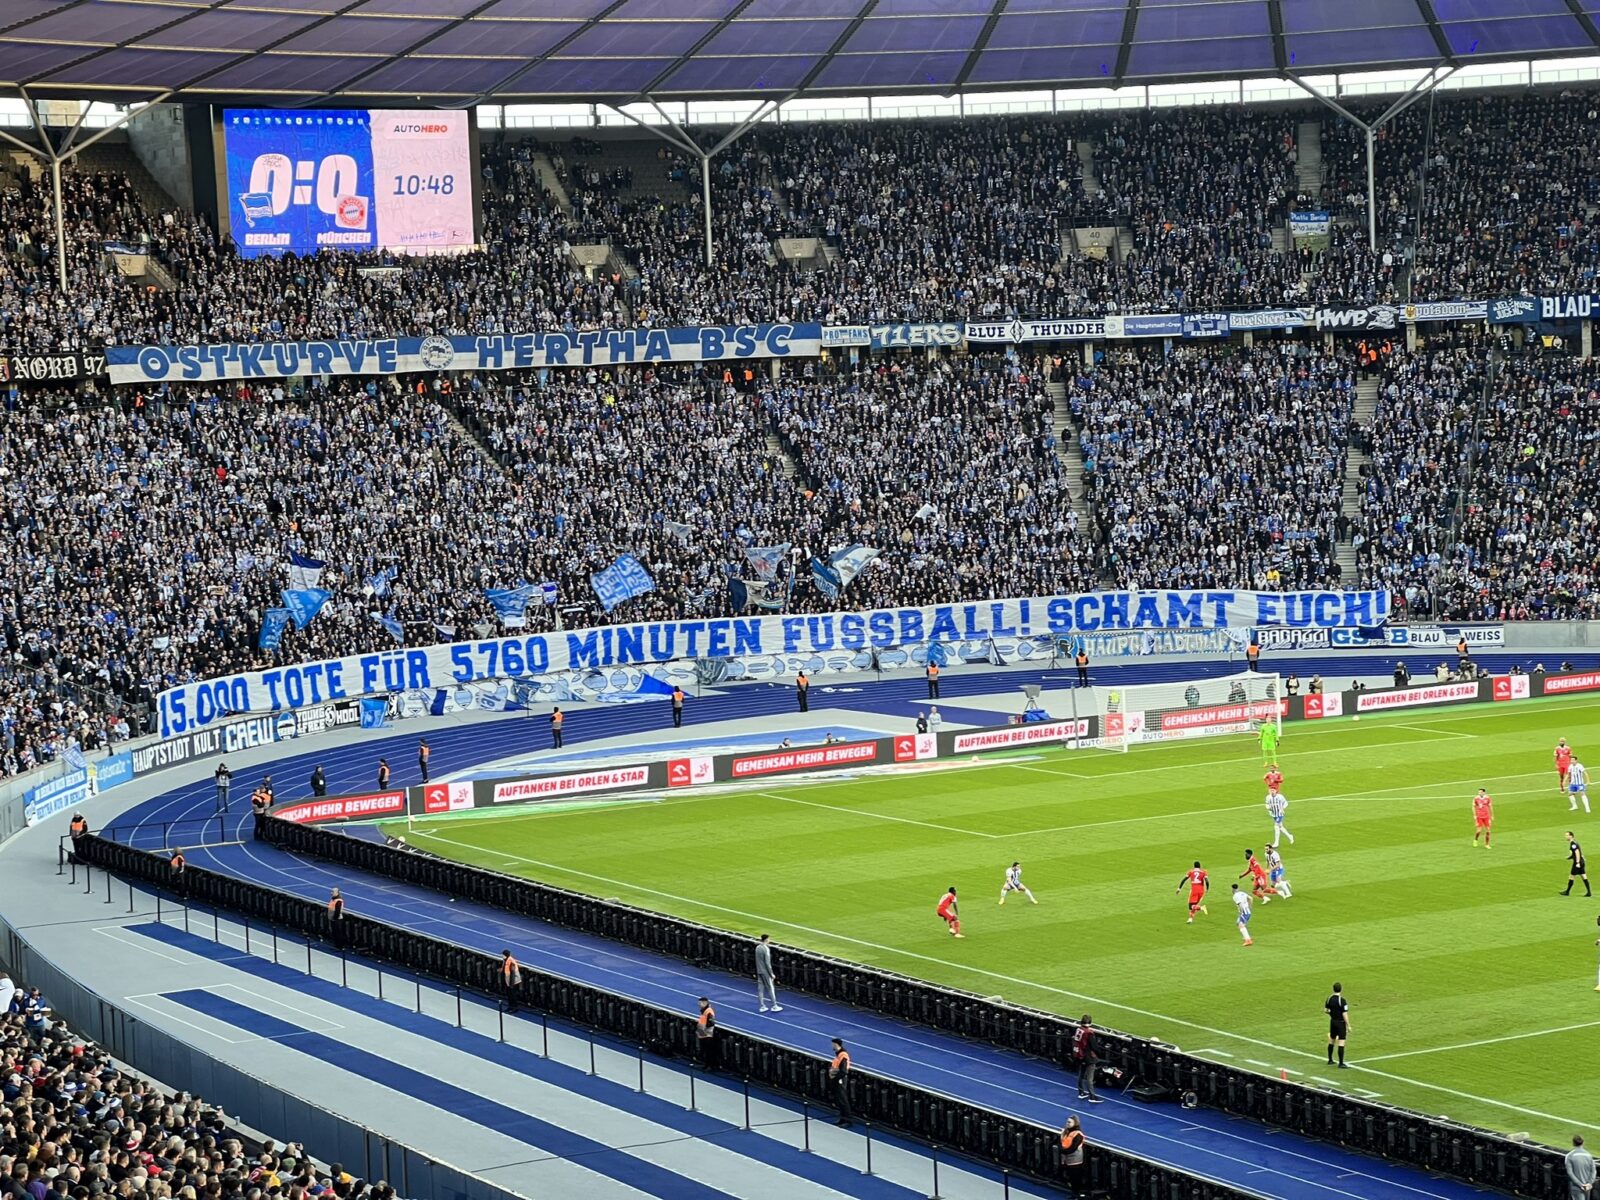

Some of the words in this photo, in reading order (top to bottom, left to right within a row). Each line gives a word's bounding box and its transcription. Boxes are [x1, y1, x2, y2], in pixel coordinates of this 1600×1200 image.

[393, 124, 448, 133] AUTOHERO
[249, 153, 358, 216] 0:0
[392, 174, 455, 195] 10:48
[245, 232, 290, 246] BERLIN
[316, 231, 371, 244] MÜNCHEN
[1230, 311, 1285, 327] Babelsberg
[871, 323, 963, 347] 71ERS
[967, 324, 1006, 339] BLUE
[1030, 322, 1105, 337] THUNDER
[137, 338, 398, 380] OSTKURVE
[474, 329, 673, 369] HERTHA
[699, 324, 795, 360] BSC
[12, 356, 78, 380] NORD
[1411, 632, 1440, 642] BLAU
[1464, 630, 1501, 641] WEISS
[158, 676, 250, 740] 15.000
[262, 661, 347, 711] TOTE
[360, 650, 431, 693] FÜR
[450, 636, 549, 683] 5.760
[566, 618, 763, 670] MINUTEN
[782, 598, 1030, 654] FUSSBALL!
[1047, 592, 1236, 634] SCHÄMT
[1255, 590, 1387, 627] EUCH!
[1546, 675, 1594, 690] GEMEINSAM
[1361, 694, 1406, 707] AUFTANKEN
[1408, 692, 1421, 702] BEI
[1423, 689, 1448, 700] ORLEN
[1449, 688, 1455, 696] &
[1456, 686, 1475, 696] STAR
[296, 707, 325, 722] YOUNG
[336, 707, 360, 725] HOOL
[1164, 711, 1216, 727] GEMEINSAM
[1217, 707, 1243, 720] MEHR
[958, 733, 1009, 749] AUFTANKEN
[1011, 731, 1026, 742] BEI
[1027, 727, 1055, 740] ORLEN
[1056, 726, 1063, 736] &
[1142, 729, 1185, 740] AUTOHERO
[1204, 723, 1246, 734] AUTOHERO
[132, 738, 191, 773] HAUPTSTADT
[193, 729, 221, 756] KULT
[225, 717, 274, 753] CREW
[736, 755, 795, 773] GEMEINSAM
[795, 751, 825, 765] MEHR
[825, 745, 874, 761] BEWEGEN
[498, 780, 557, 798] AUFTANKEN
[559, 779, 576, 790] BEI
[578, 774, 610, 787] ORLEN
[611, 773, 619, 784] &
[620, 770, 645, 783] STAR
[313, 801, 343, 817] MEHR
[345, 796, 400, 813] BEWEGEN
